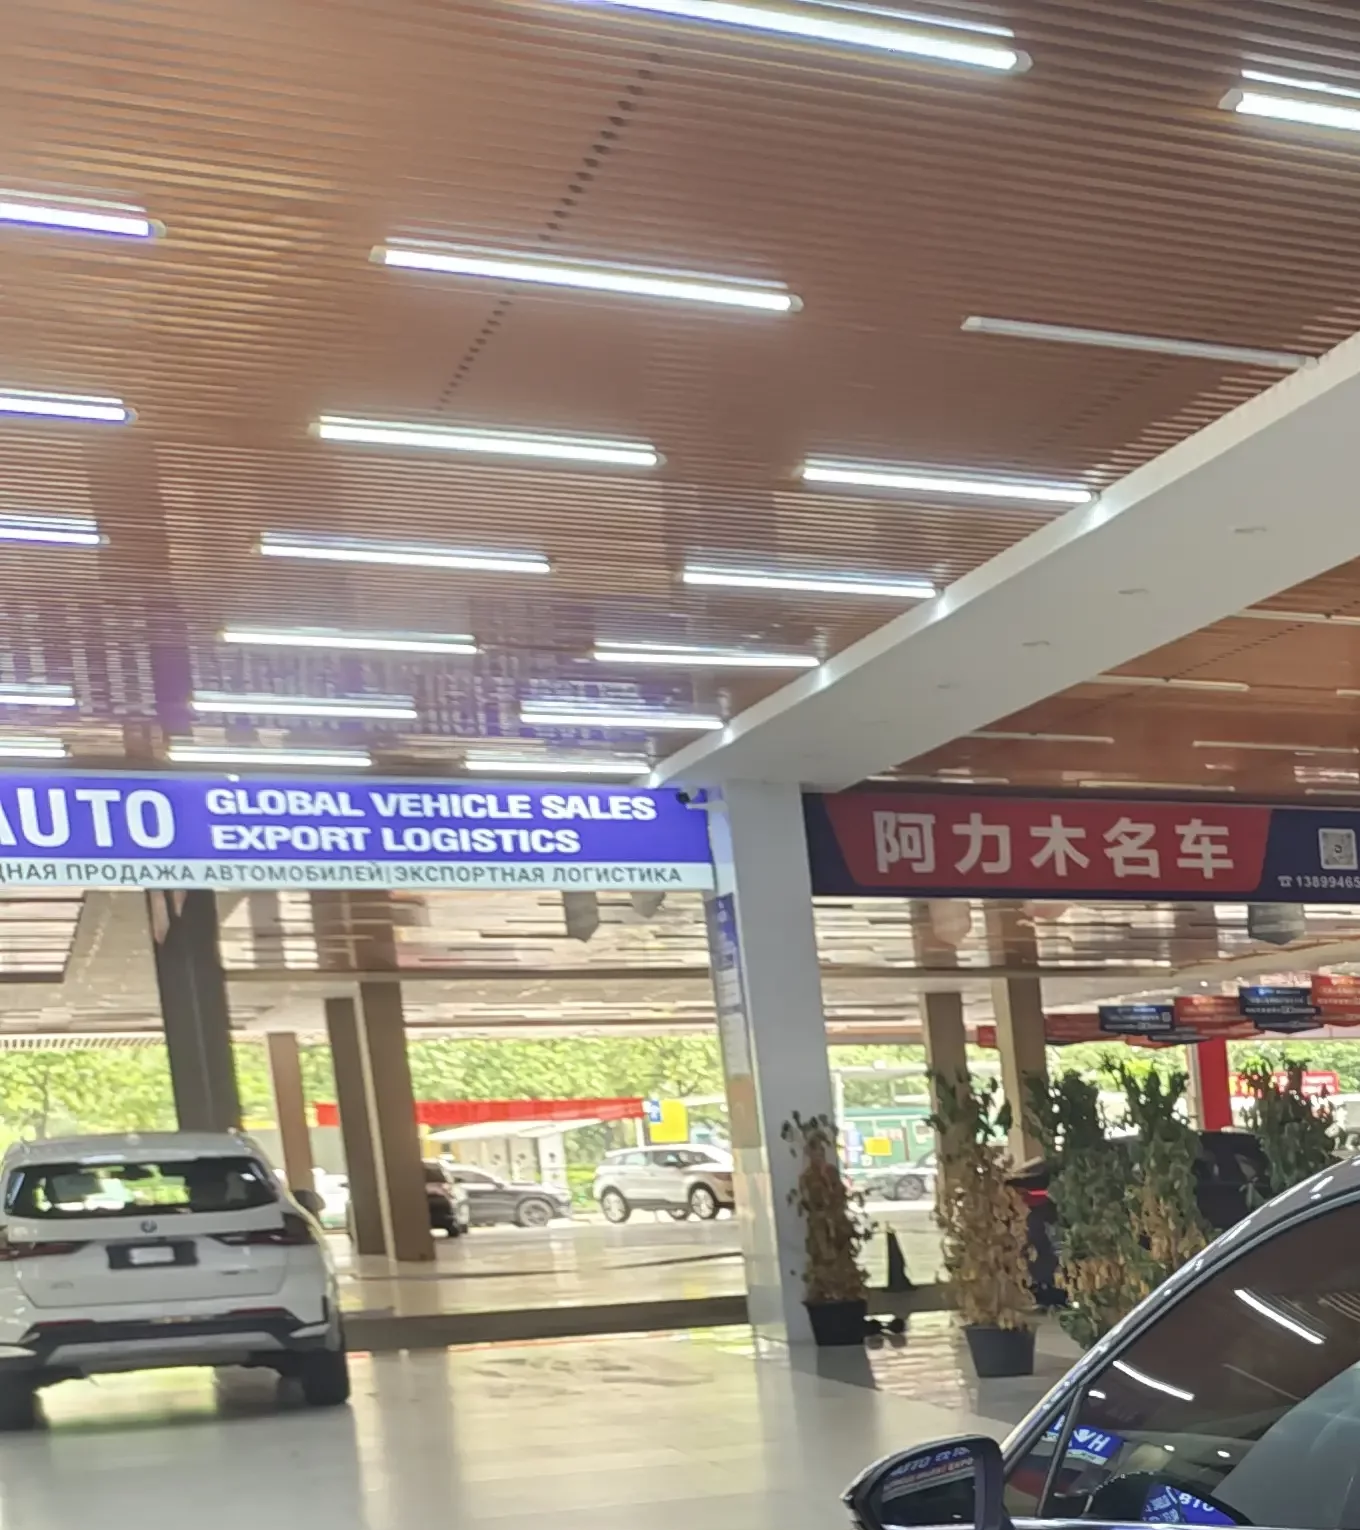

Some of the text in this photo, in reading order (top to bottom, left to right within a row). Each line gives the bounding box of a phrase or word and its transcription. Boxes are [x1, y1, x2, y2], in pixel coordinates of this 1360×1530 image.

[206, 788, 658, 821] GLOBAL VEHICLE SALES
[211, 825, 582, 853] EXPORT LOGISTICS
[872, 810, 1235, 880] 阿力木名车
[66, 864, 196, 885] ПРОДАЖА
[552, 867, 683, 883] ЛОГИСТИКА
